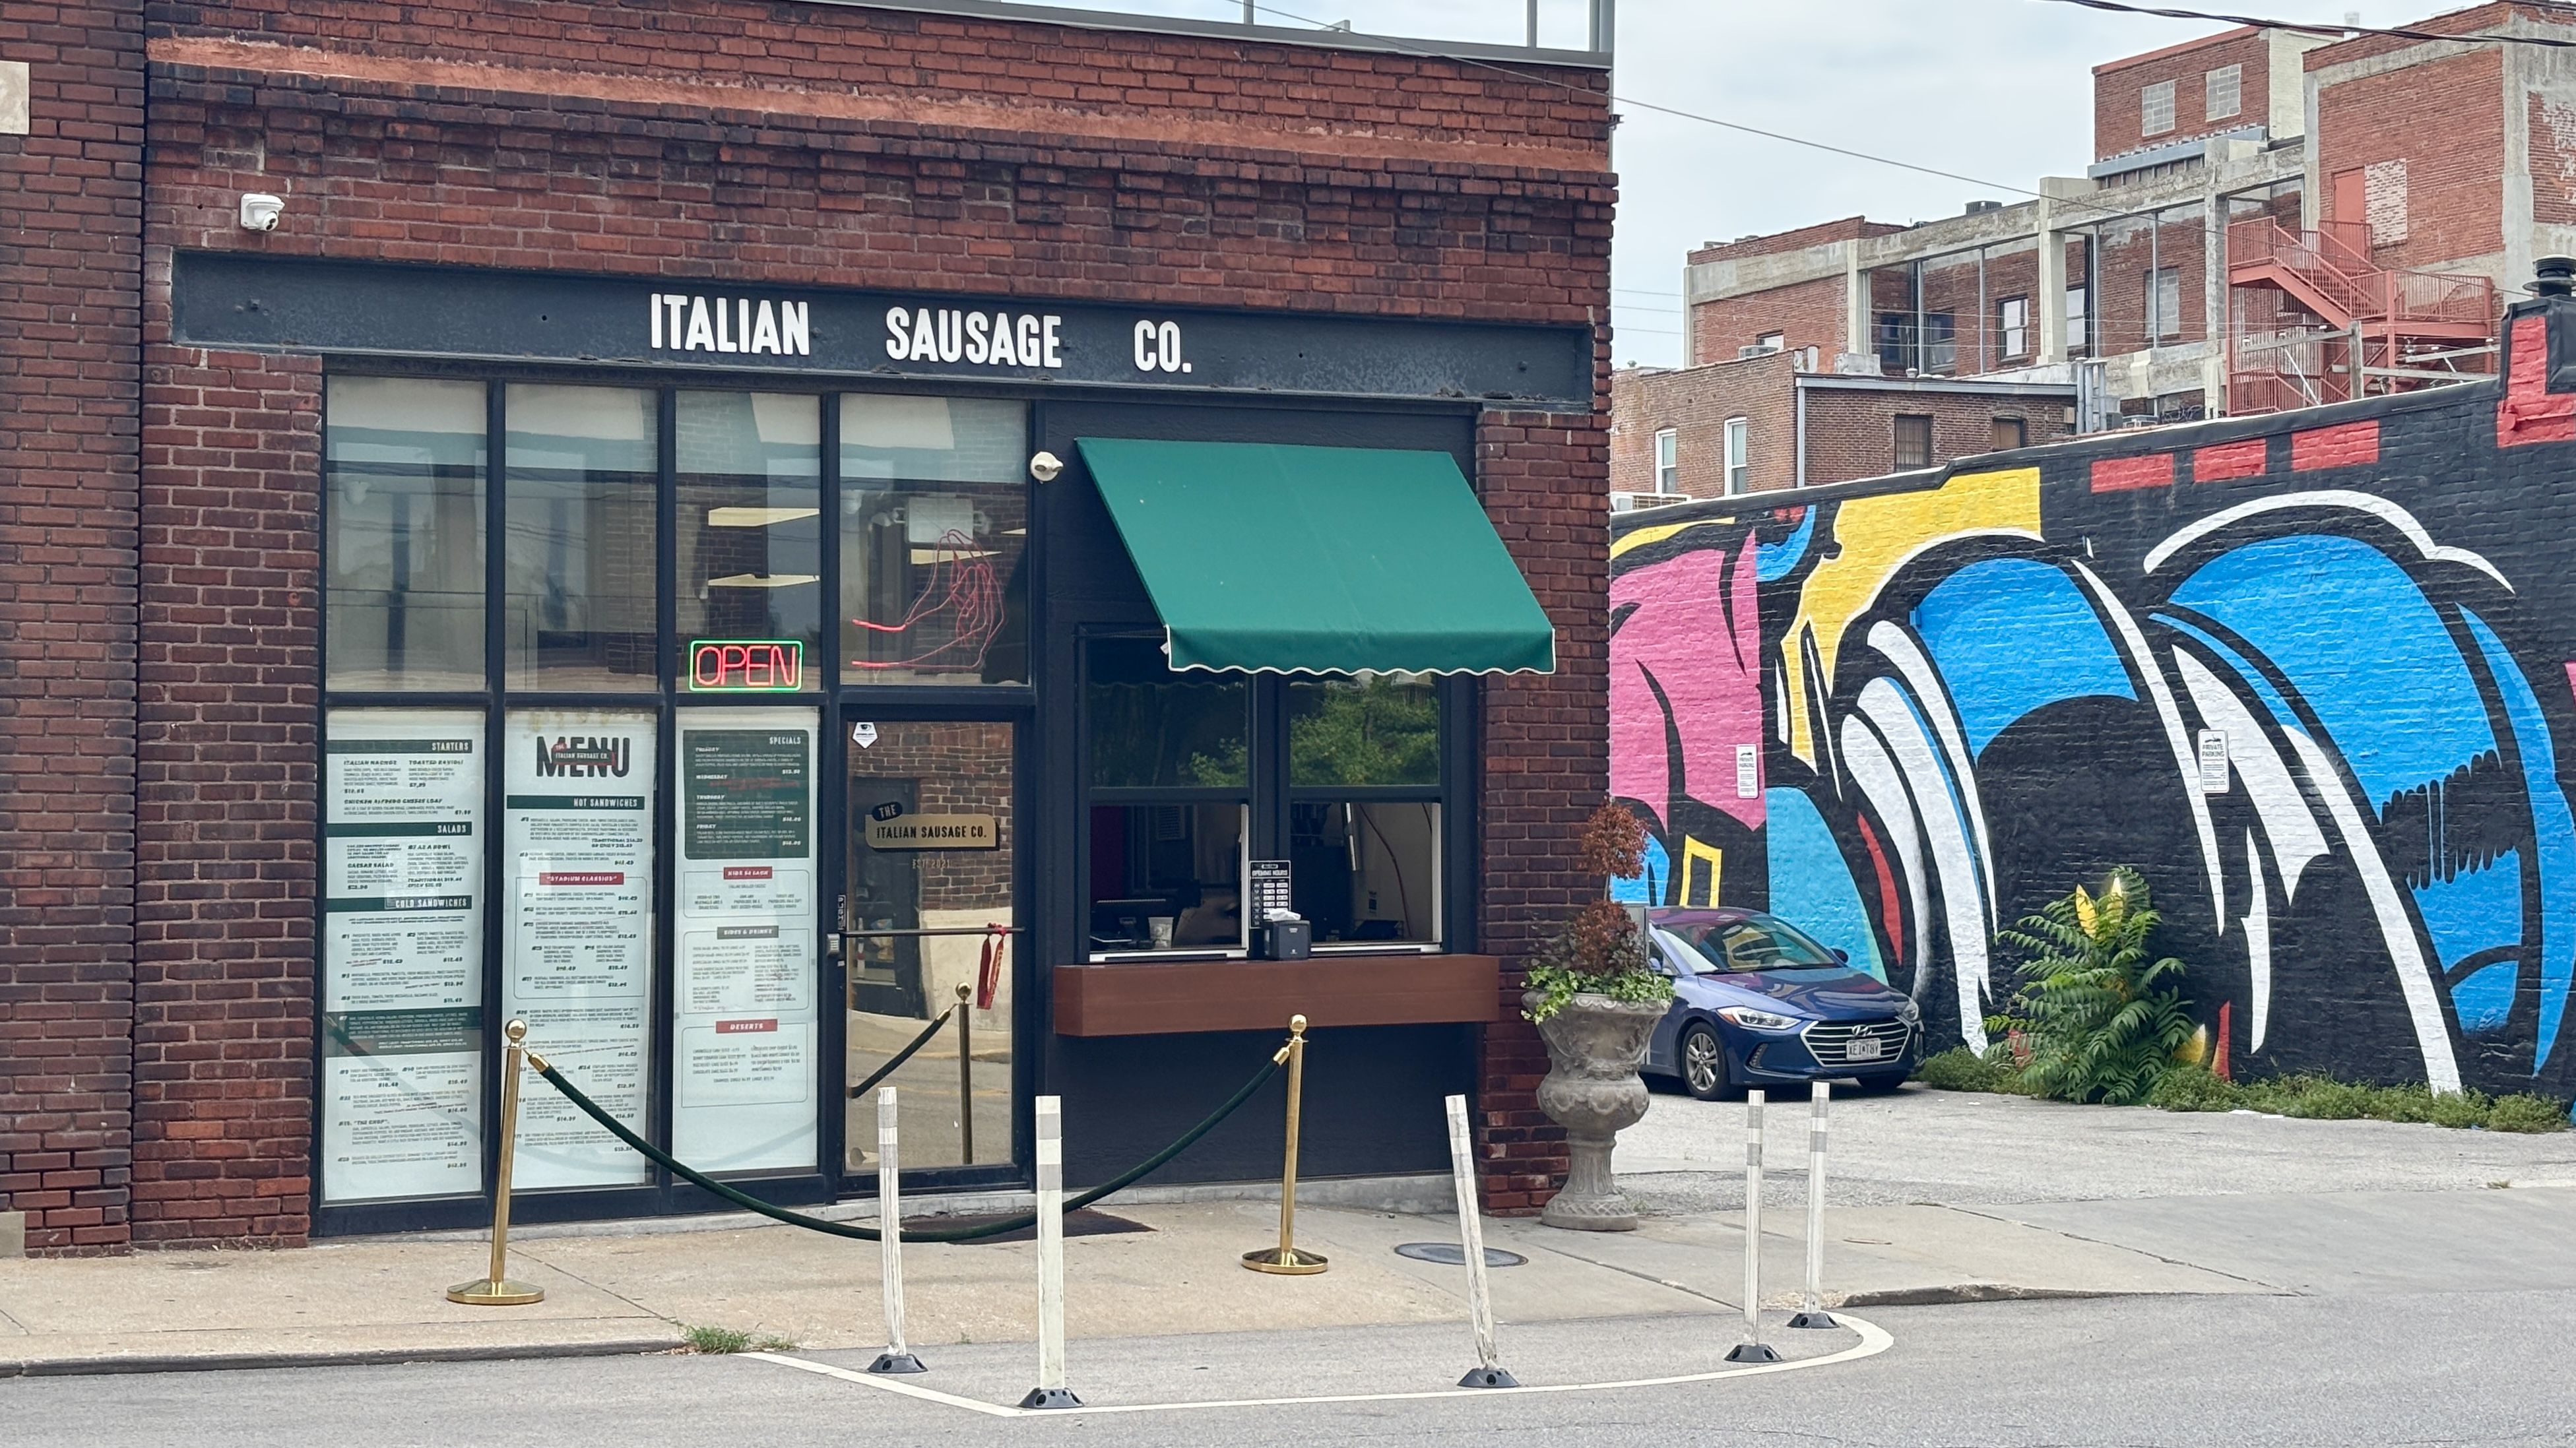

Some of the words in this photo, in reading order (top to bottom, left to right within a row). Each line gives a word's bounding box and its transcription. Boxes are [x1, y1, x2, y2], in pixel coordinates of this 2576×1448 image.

[651, 293, 810, 356] ITALIAN
[885, 306, 1062, 367] SAUSAGE
[1134, 319, 1192, 373] CO.
[695, 645, 796, 686] OPEN
[769, 736, 801, 745] SPECIALS
[432, 742, 468, 751] STARTERS
[536, 736, 631, 778] MENU
[574, 798, 587, 807] HOT
[590, 798, 638, 807] SANDWICHES
[878, 804, 897, 819] THE
[437, 824, 466, 833] SALADS
[877, 826, 917, 838] ITALIAN
[922, 826, 966, 838] SAUSAGE
[971, 825, 987, 838] CO.
[931, 859, 950, 869] 2021
[396, 899, 415, 908] COLD
[418, 898, 467, 908] SANDWICHES
